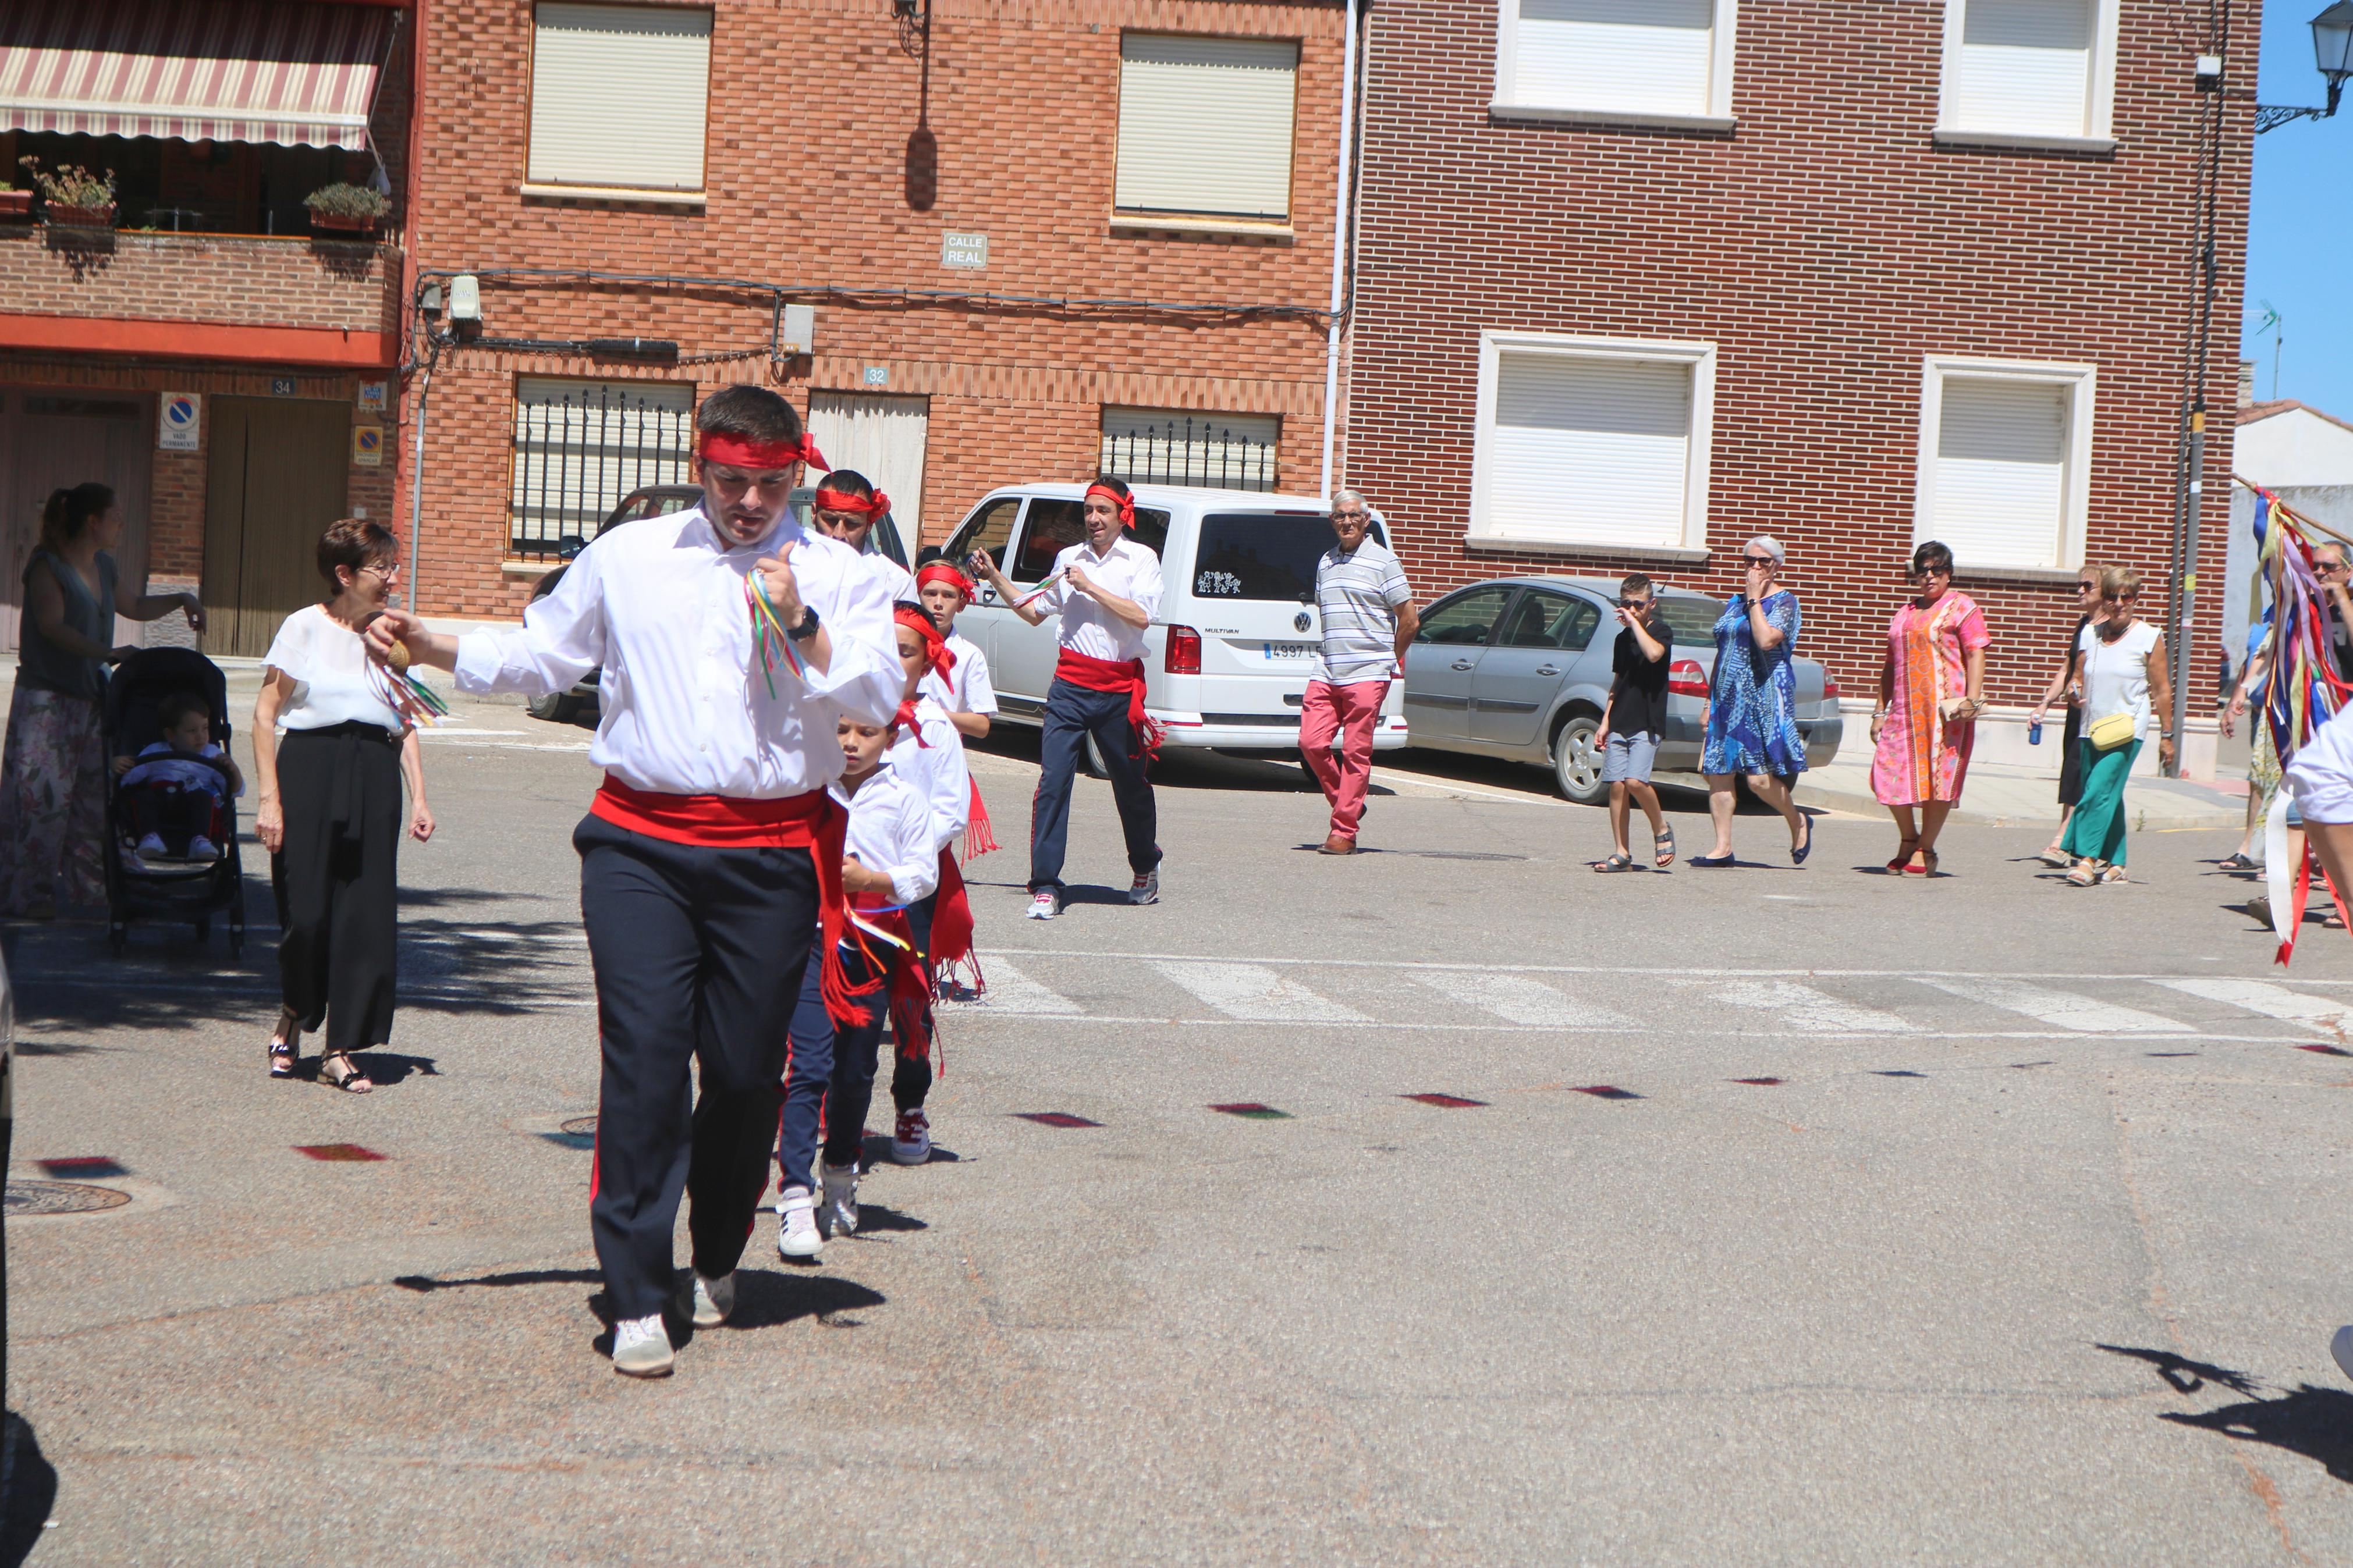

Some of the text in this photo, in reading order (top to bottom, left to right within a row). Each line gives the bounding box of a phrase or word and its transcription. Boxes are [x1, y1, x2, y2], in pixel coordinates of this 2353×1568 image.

[949, 236, 982, 248] CALLE
[948, 250, 982, 263] REAL
[869, 369, 884, 382] 32
[275, 381, 290, 394] 34
[162, 439, 196, 448] PERMANENTE
[1273, 645, 1304, 658] 4997
